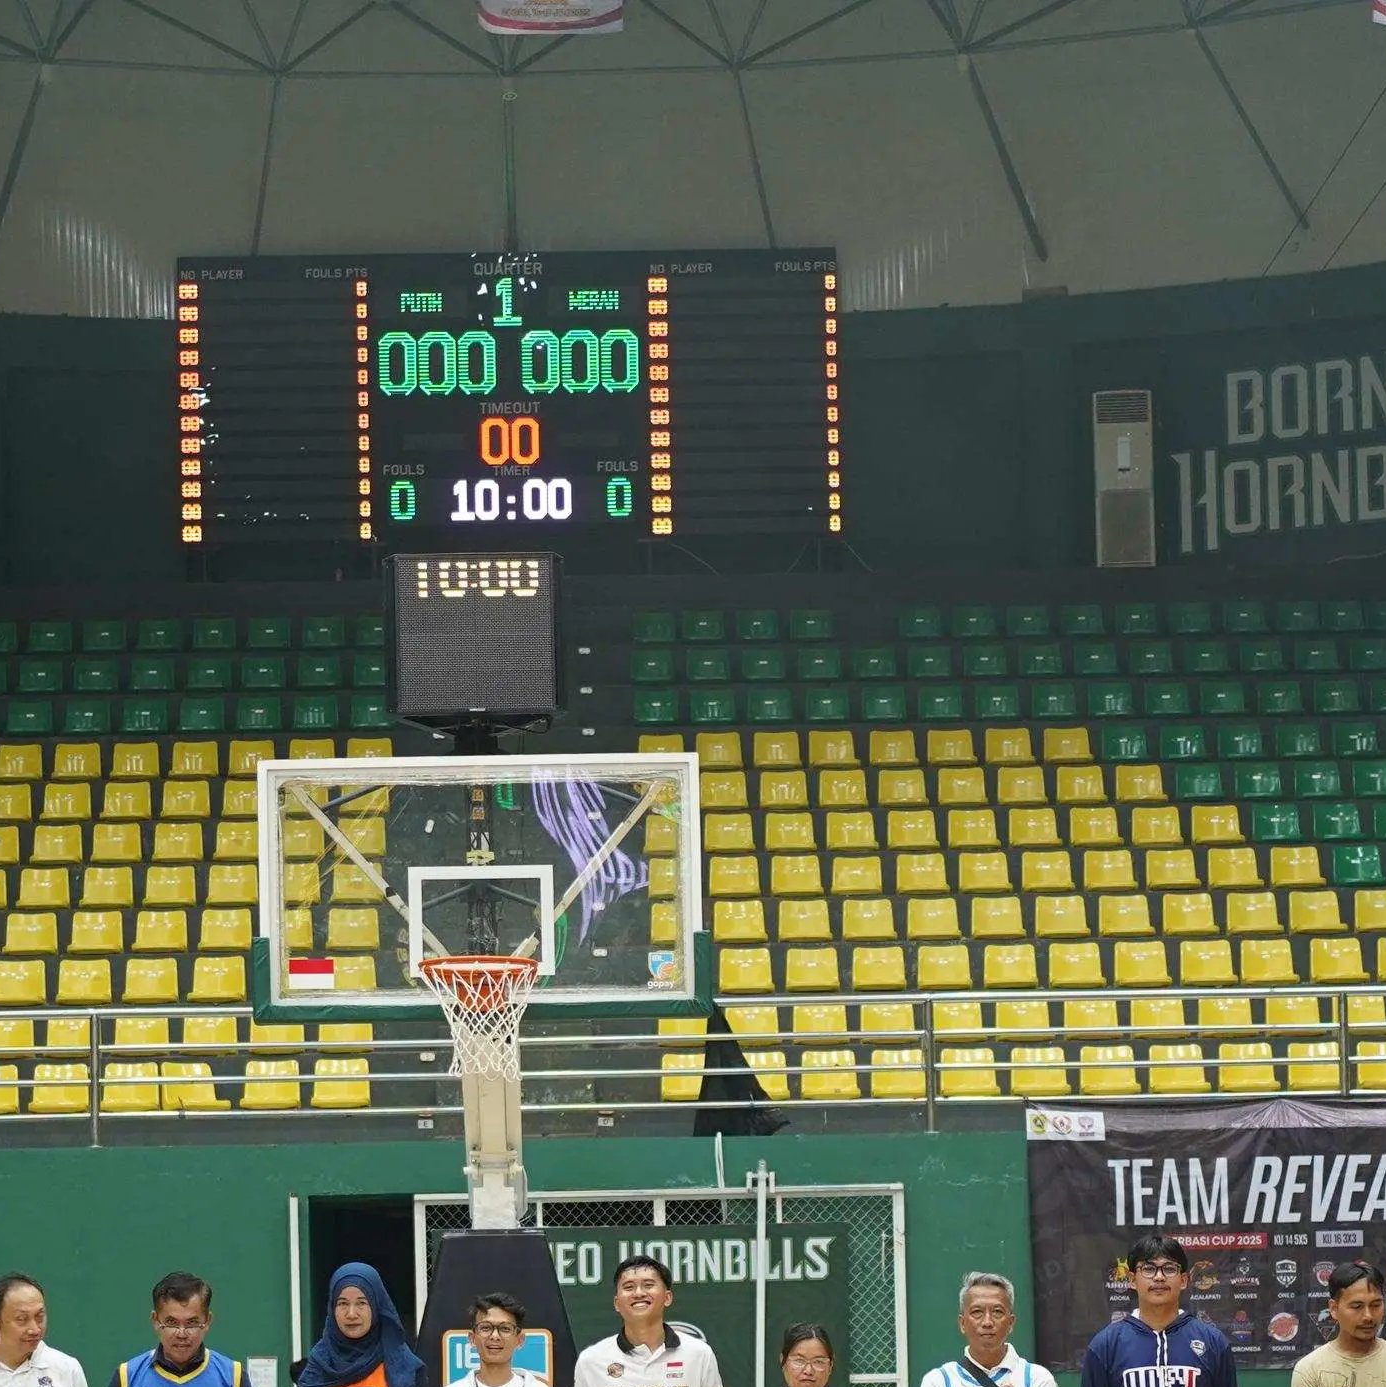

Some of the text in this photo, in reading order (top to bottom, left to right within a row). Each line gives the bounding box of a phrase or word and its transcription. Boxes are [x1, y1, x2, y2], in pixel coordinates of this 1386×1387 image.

[305, 267, 368, 279] FOULS PTS
[474, 262, 543, 276] QUARTER
[650, 263, 713, 274] NO PLAYER
[775, 260, 836, 272] FOULS PTS
[181, 269, 244, 280] NO PLAYER
[493, 278, 522, 327] 1
[378, 331, 497, 396] 000
[521, 329, 640, 395] 000
[479, 401, 541, 415] TIMEOUT
[480, 416, 540, 466] 00
[383, 464, 425, 476] FOULS
[494, 465, 531, 476] TIMER
[597, 461, 639, 473] FOULS
[390, 481, 416, 520] 0
[450, 477, 573, 521] 10:00
[606, 477, 633, 517] 0
[417, 561, 539, 598] 10:00
[1108, 1156, 1229, 1227] TEAM
[1213, 1235, 1236, 1246] CUP
[1237, 1235, 1262, 1246] 2025
